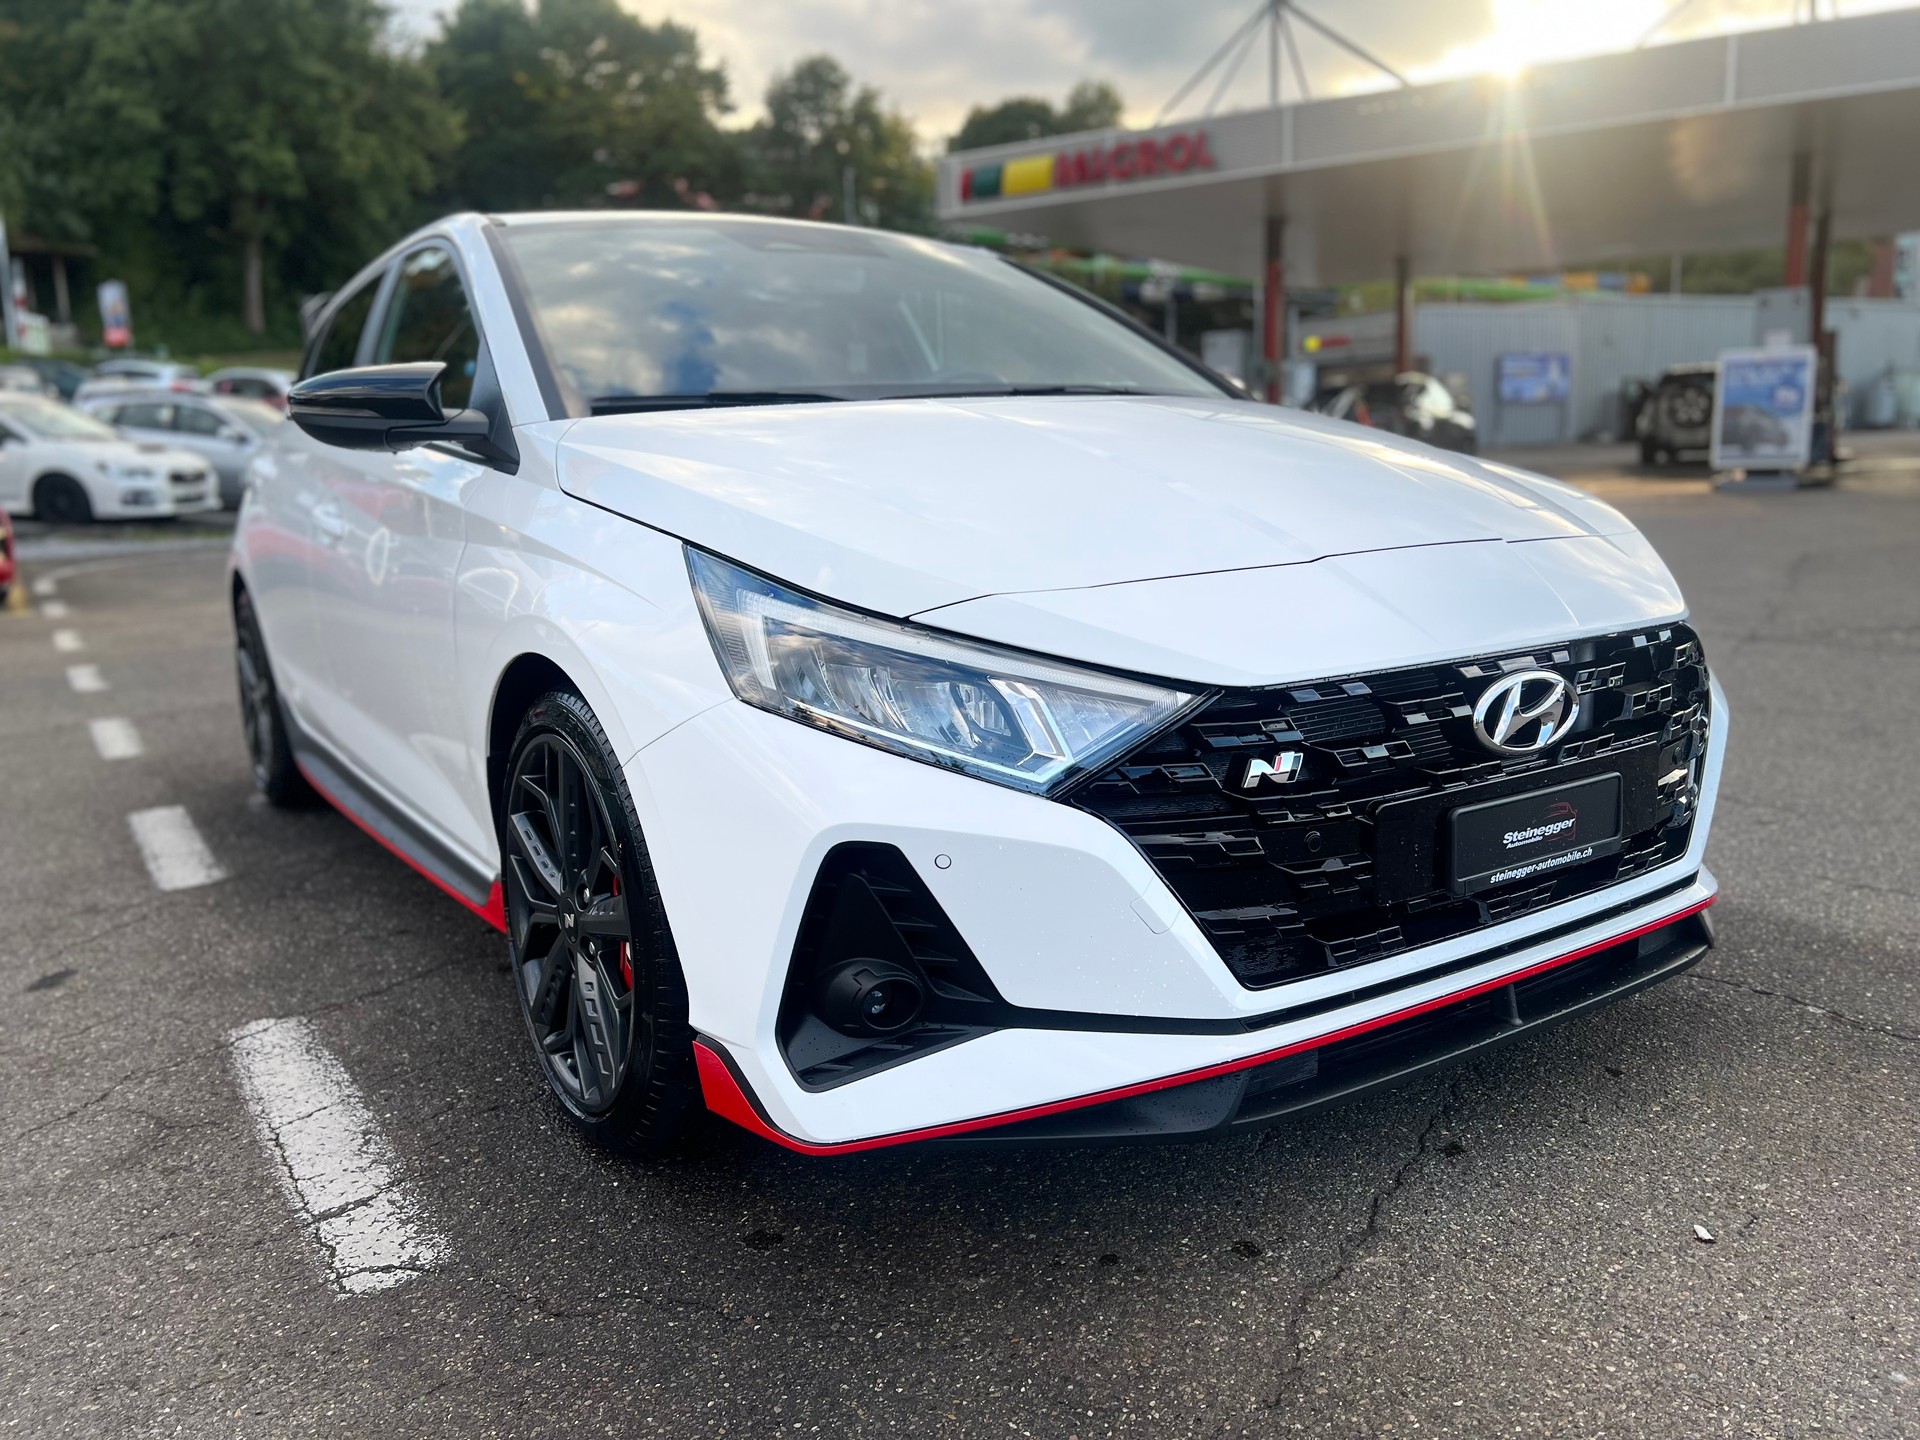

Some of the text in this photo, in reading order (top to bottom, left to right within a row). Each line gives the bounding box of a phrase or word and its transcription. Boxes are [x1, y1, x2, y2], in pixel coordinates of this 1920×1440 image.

[1055, 130, 1215, 188] MIGROL
[1503, 818, 1576, 844] Steinegger
[1506, 836, 1543, 849] Automobile
[1490, 847, 1593, 883] steinegger-automobile.ch
